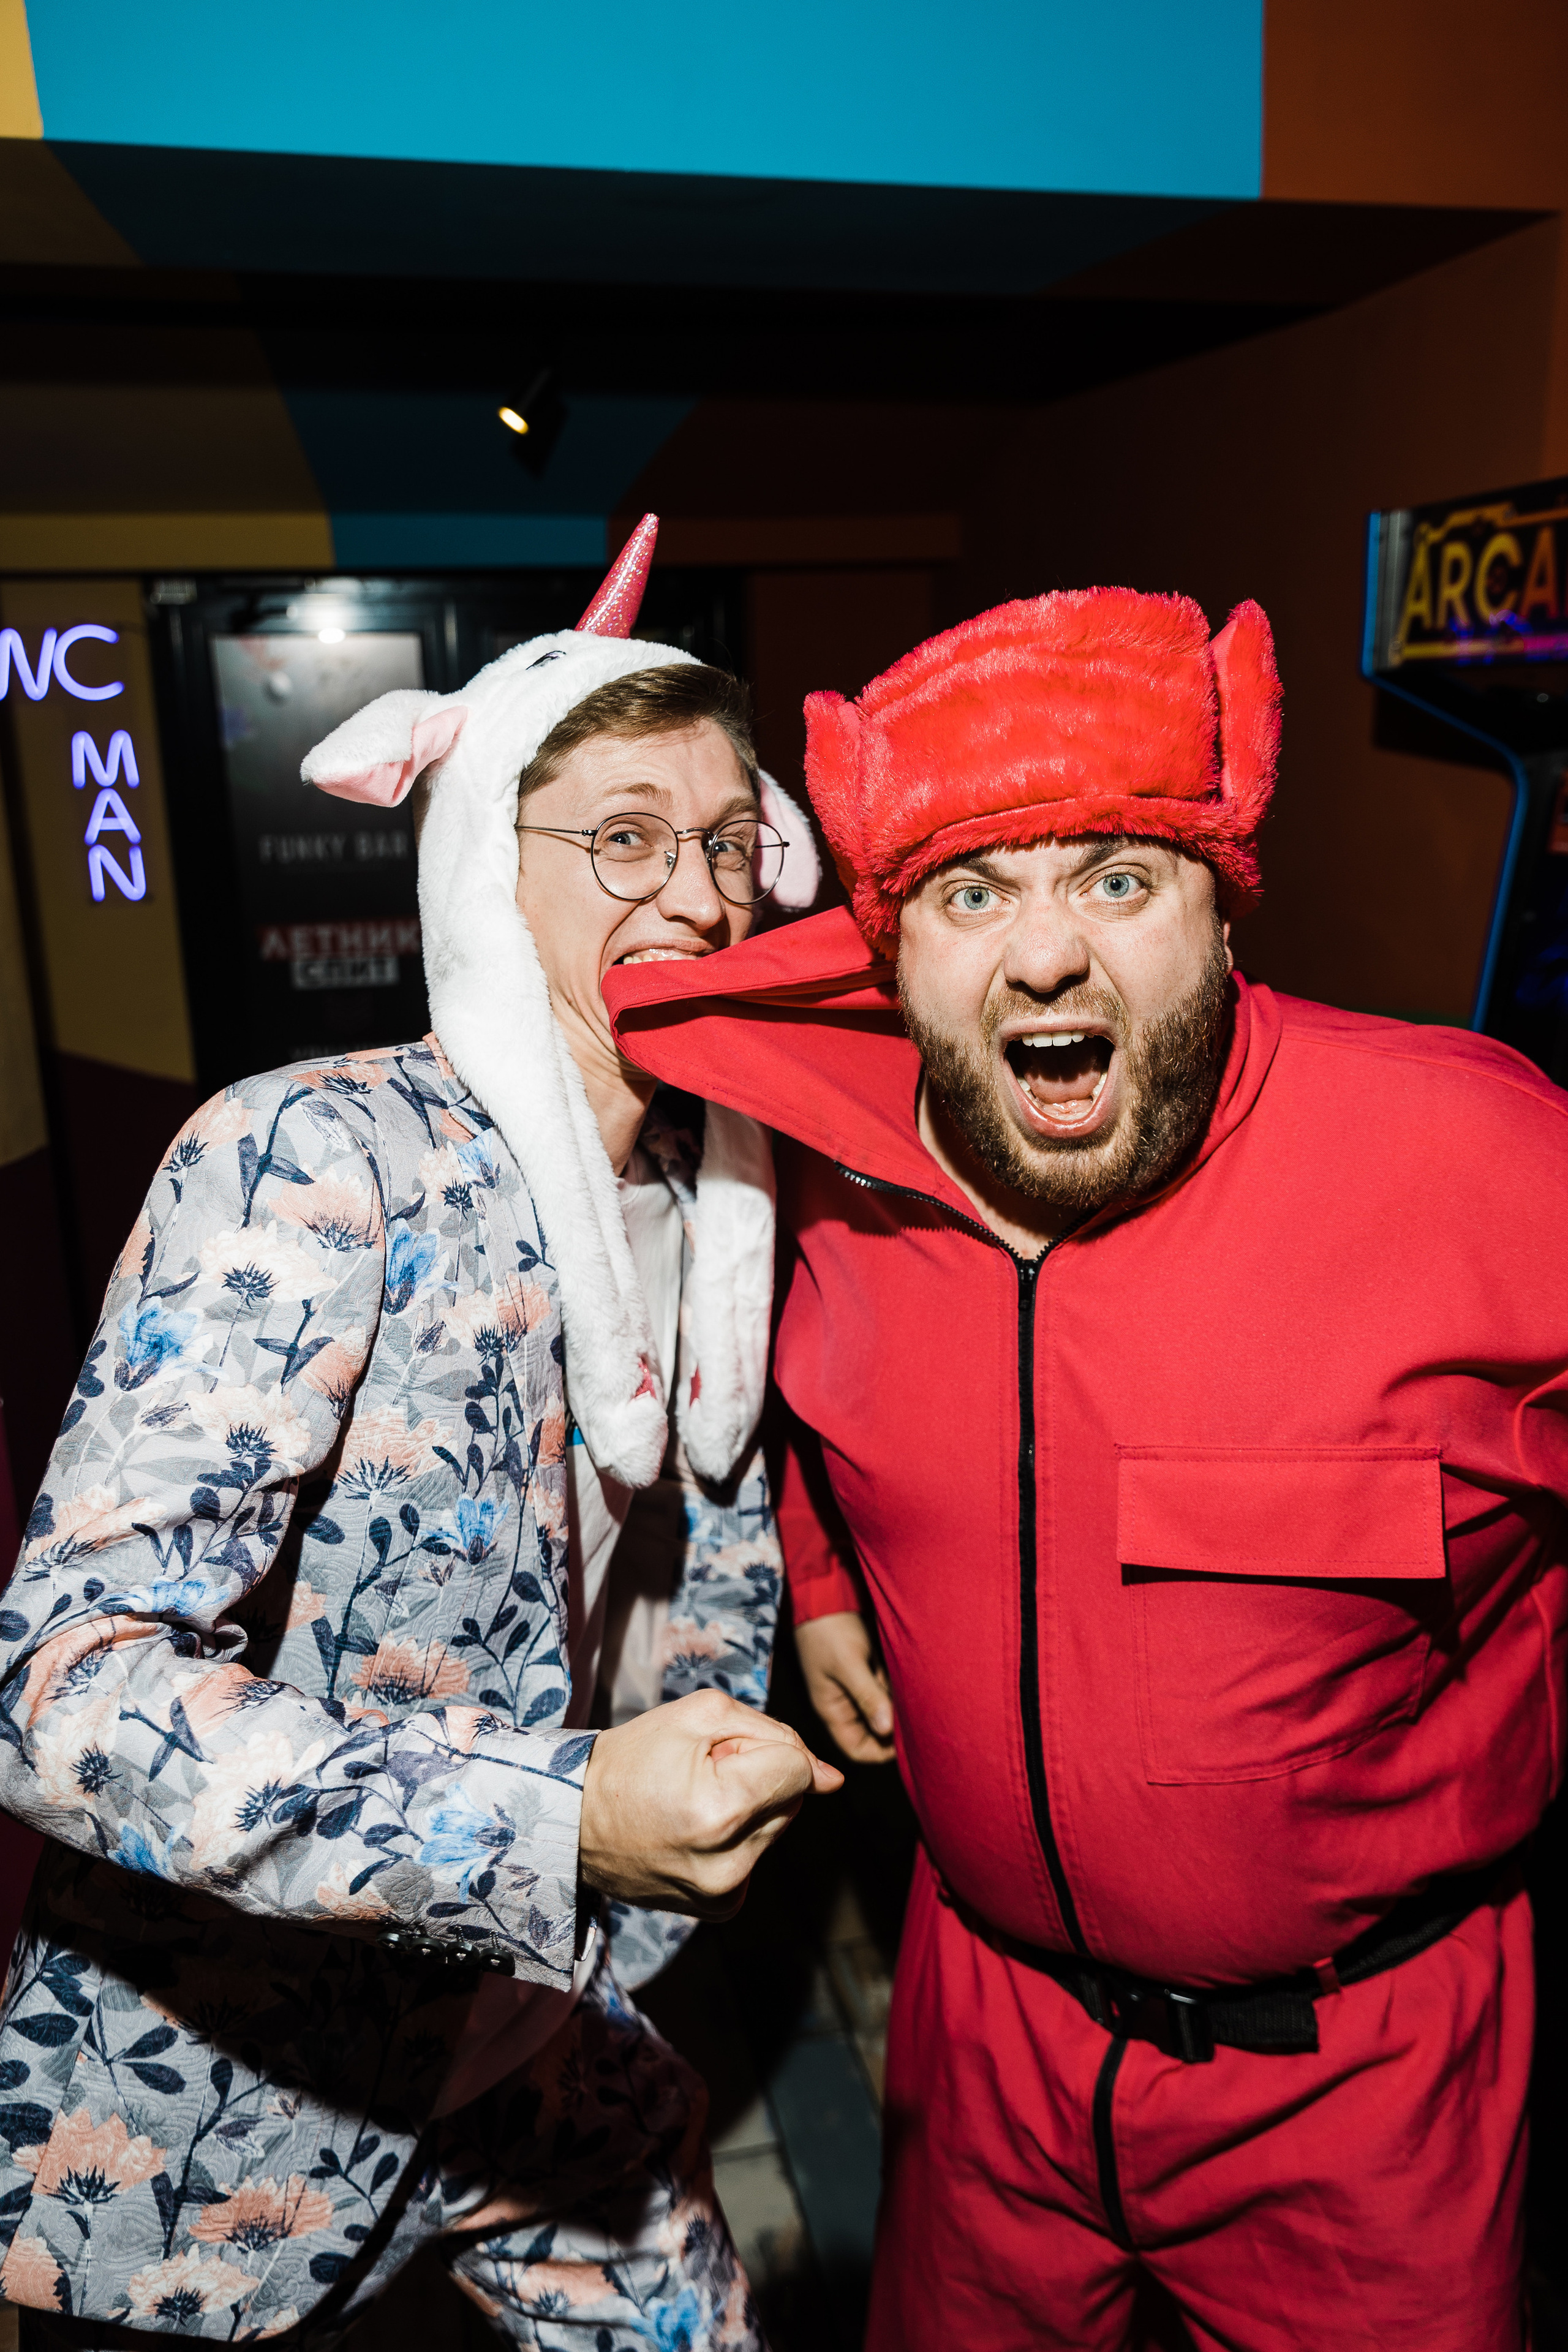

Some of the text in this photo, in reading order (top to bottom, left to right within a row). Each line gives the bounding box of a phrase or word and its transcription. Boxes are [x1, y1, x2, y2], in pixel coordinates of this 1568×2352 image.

[1396, 524, 1568, 636] ARCA
[72, 729, 146, 902] MAN
[259, 830, 407, 863] FUNKY BAR
